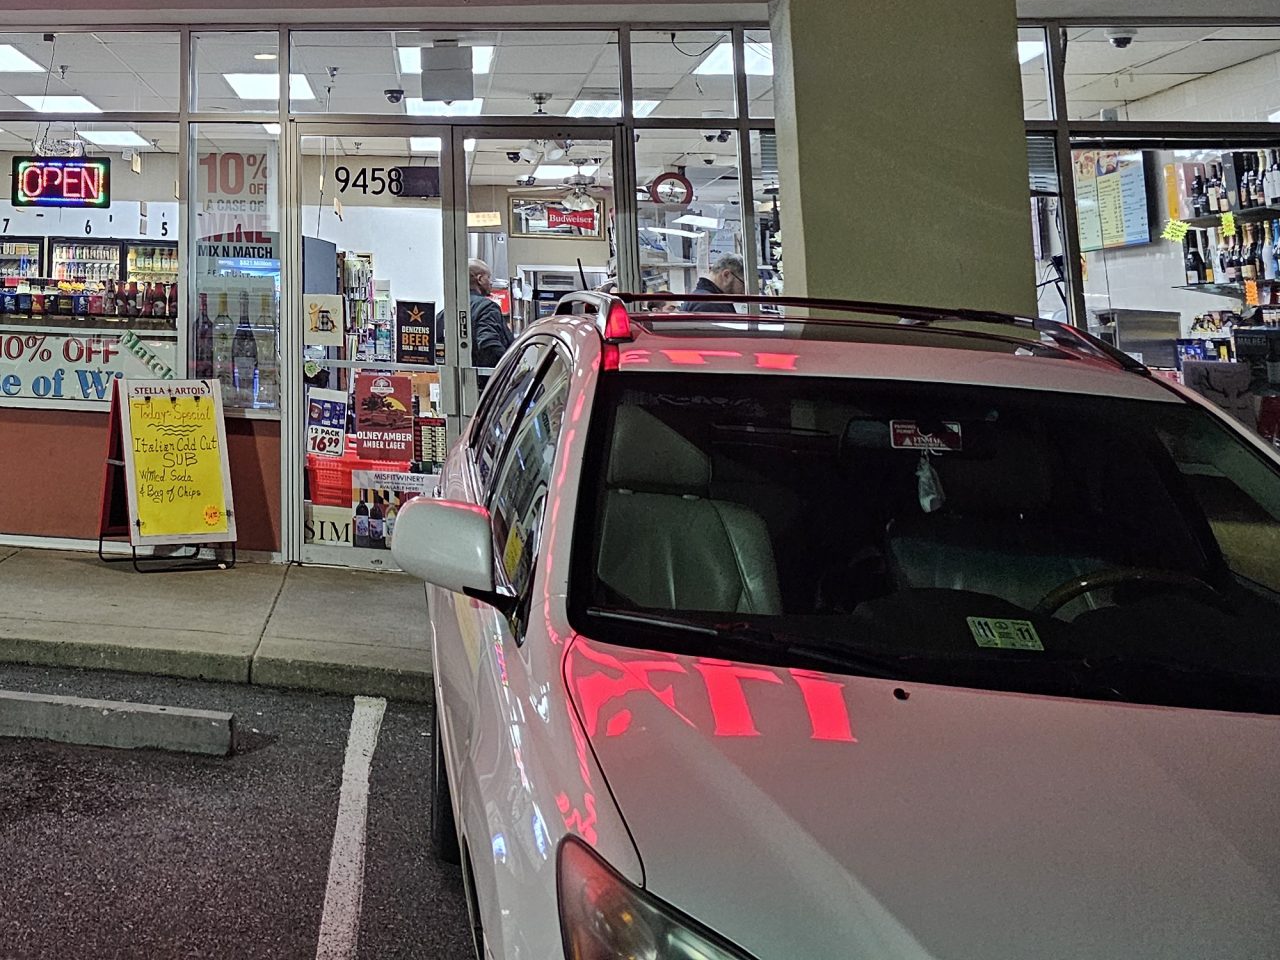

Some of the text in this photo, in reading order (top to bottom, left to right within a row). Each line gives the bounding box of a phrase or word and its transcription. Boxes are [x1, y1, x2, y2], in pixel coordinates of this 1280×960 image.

[199, 152, 272, 195] 10%
[23, 166, 99, 198] OPEN
[335, 166, 403, 196] 9458
[206, 200, 264, 212] A CASE OF
[549, 213, 594, 224] Budweiser
[2, 219, 10, 233] 7
[85, 220, 92, 235] 6
[161, 222, 168, 236] 5
[199, 213, 272, 243] WINE
[198, 245, 273, 259] MIX N MATCH
[401, 325, 430, 334] DENIZENS
[401, 334, 429, 346] BEER
[62, 337, 121, 365] OFF
[121, 329, 177, 379] Match
[31, 368, 66, 398] of
[135, 386, 205, 395] STELLA ARTOIS
[173, 403, 211, 424] Special
[321, 429, 340, 437] PACK
[357, 430, 412, 442] OLNEY AMBER
[135, 437, 174, 453] Italian
[200, 435, 218, 451] Cut
[363, 441, 406, 449] AMBER LAGER
[163, 452, 198, 467] SUB
[170, 469, 193, 482] Soda
[147, 486, 164, 504] Bag
[167, 486, 176, 502] of
[177, 486, 202, 500] Chips
